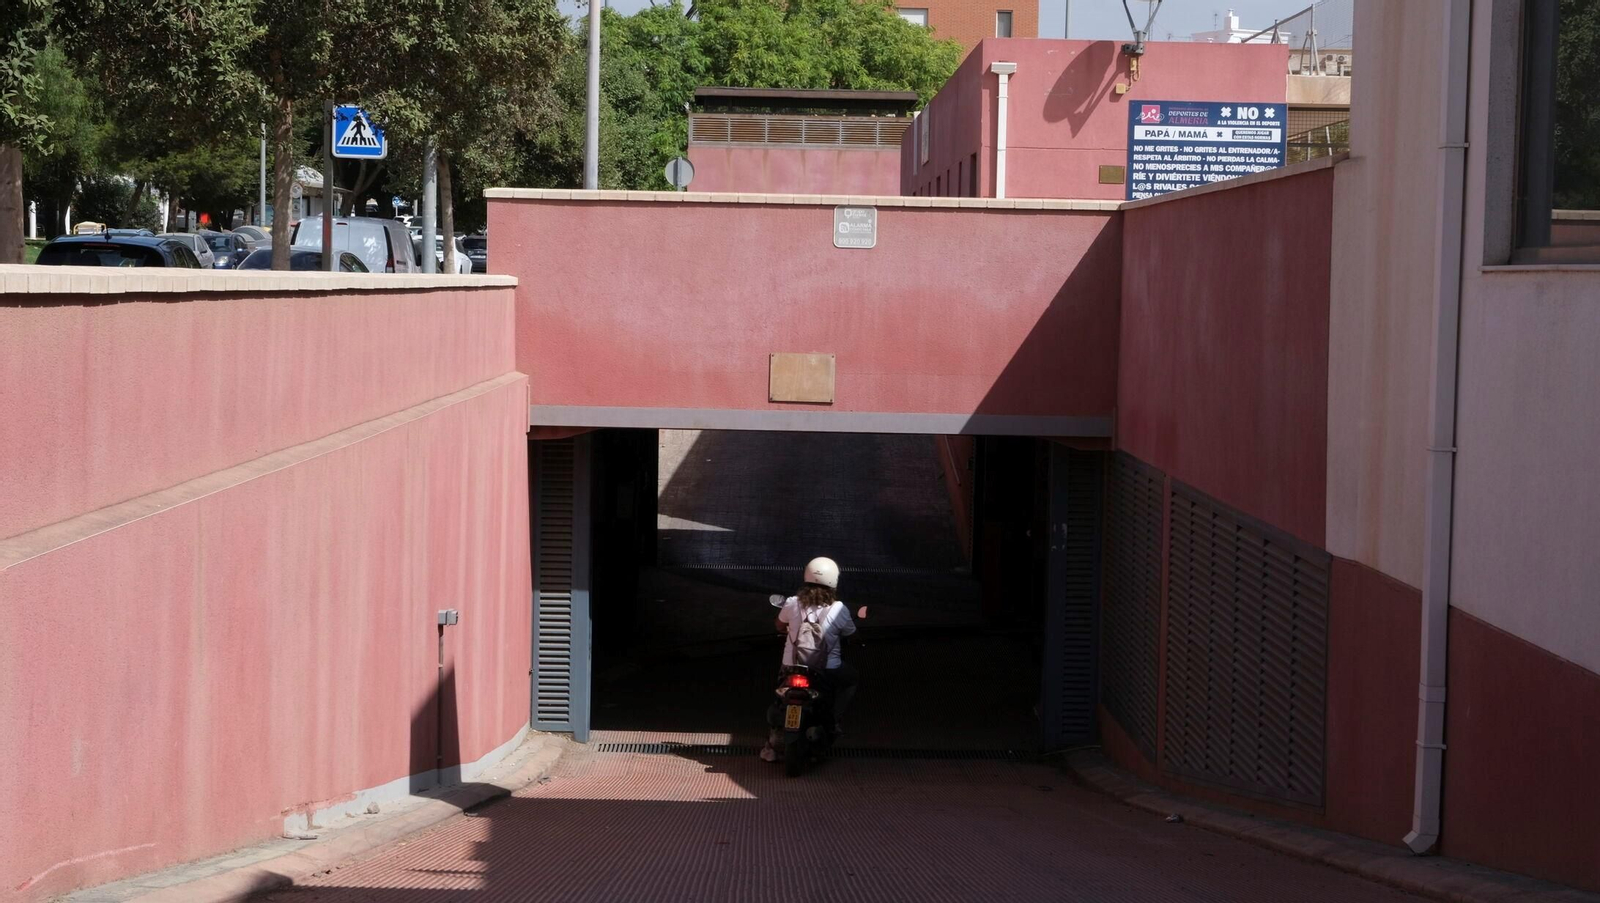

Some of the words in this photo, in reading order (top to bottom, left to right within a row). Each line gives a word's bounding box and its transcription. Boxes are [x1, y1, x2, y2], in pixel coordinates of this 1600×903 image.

[1237, 107, 1259, 120] NO
[1145, 128, 1170, 137] PAPÁ
[1179, 129, 1208, 138] MAMÁ
[1133, 172, 1146, 180] RÍE
[1156, 172, 1201, 181] DIVIÉRTETE
